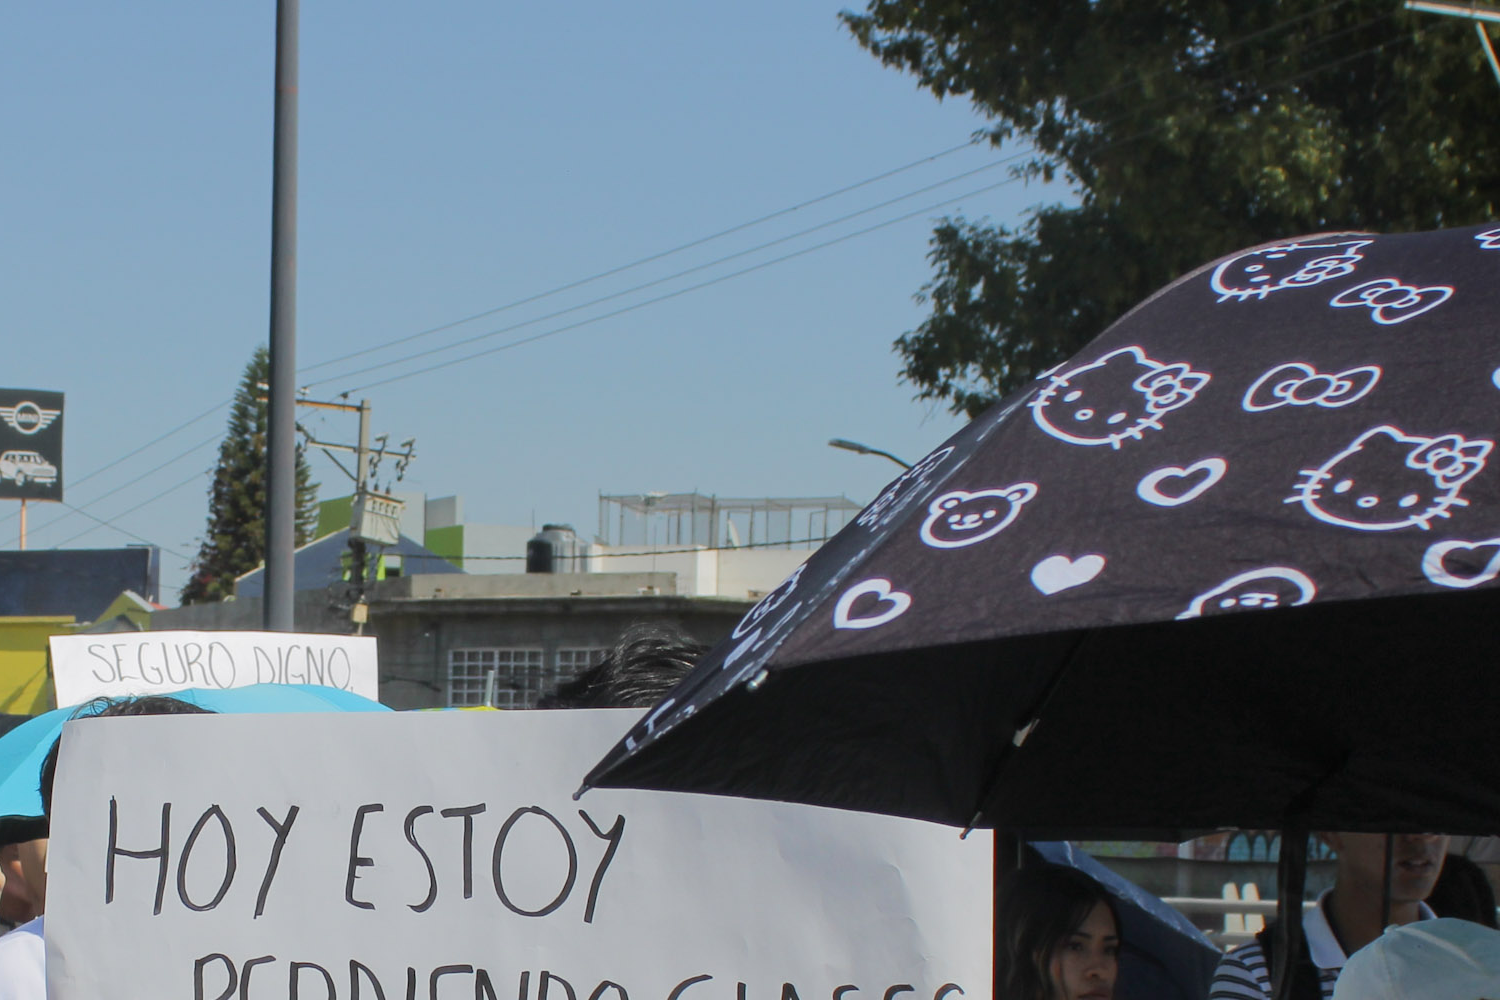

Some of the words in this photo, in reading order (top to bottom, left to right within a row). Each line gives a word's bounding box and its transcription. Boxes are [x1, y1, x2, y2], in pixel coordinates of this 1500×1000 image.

[87, 641, 236, 689] SEGURO
[106, 796, 299, 920] HOY
[345, 802, 626, 924] ESTOY
